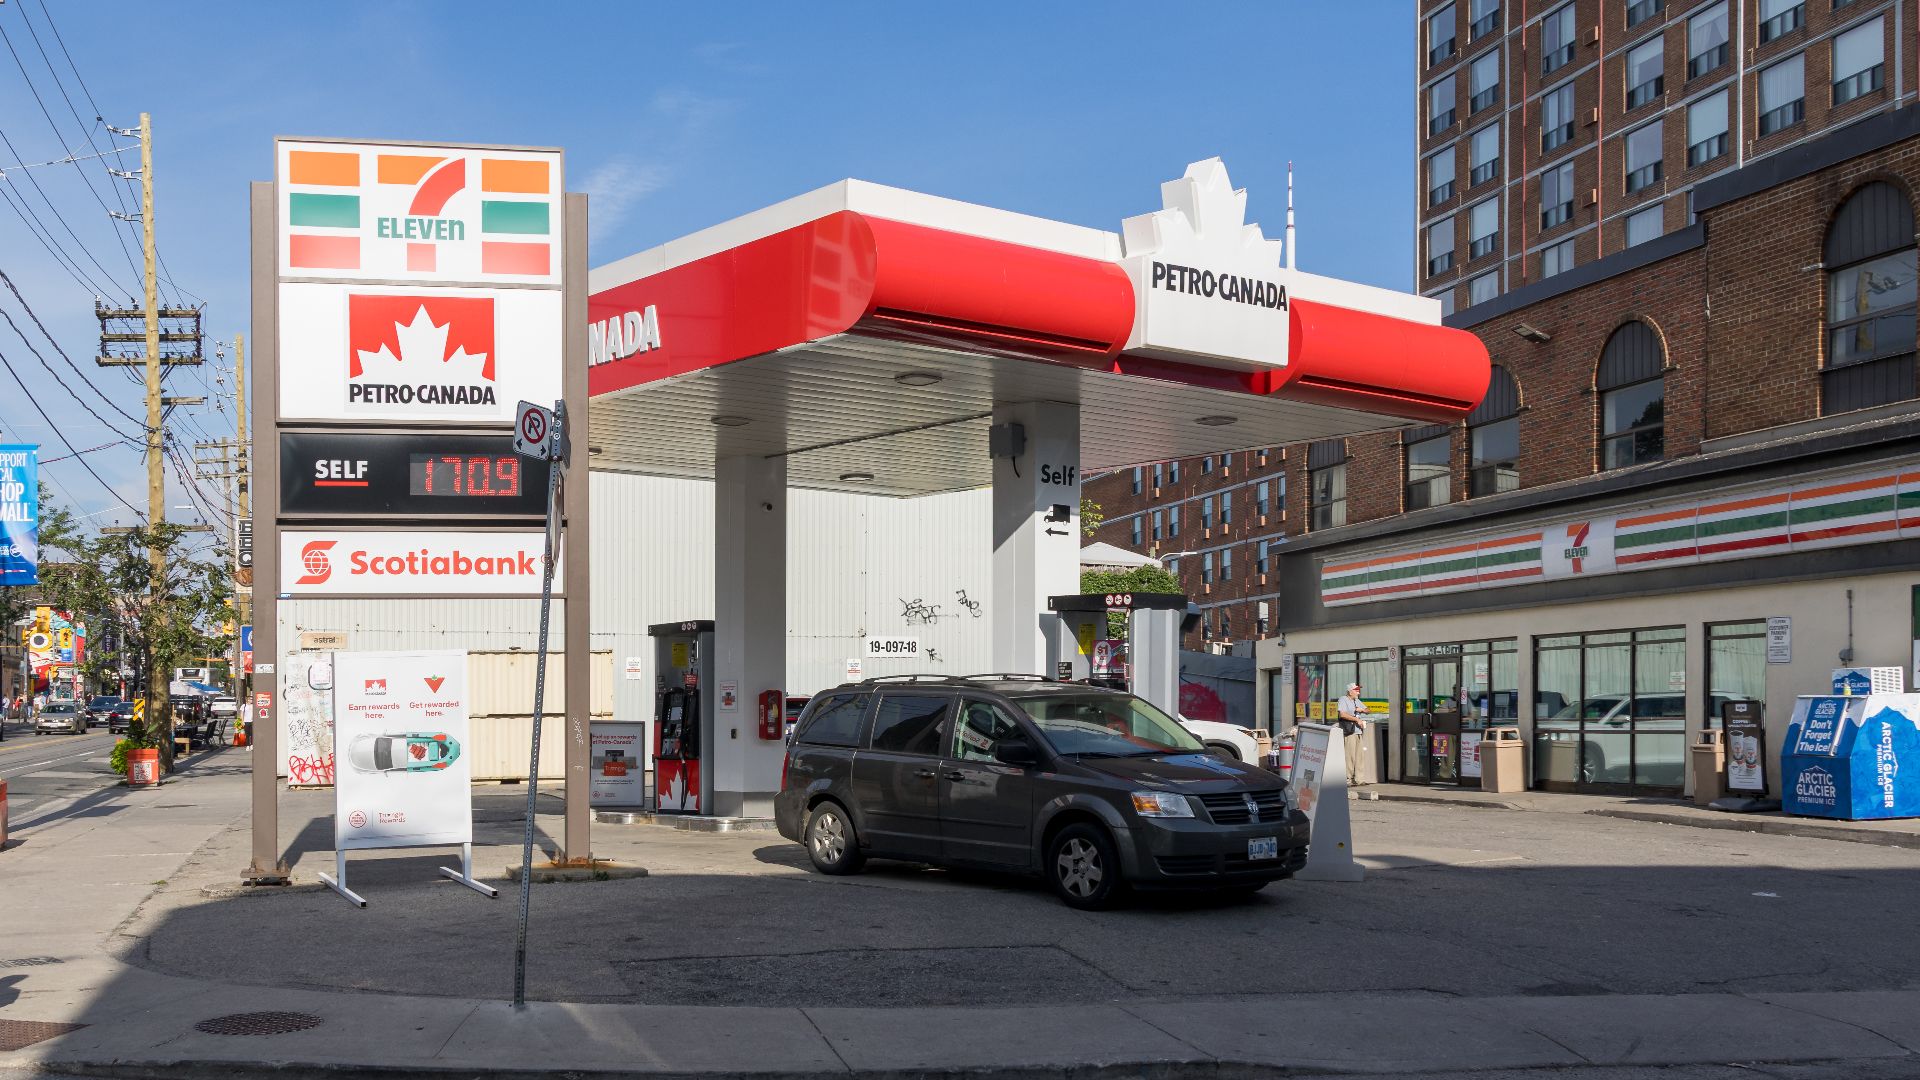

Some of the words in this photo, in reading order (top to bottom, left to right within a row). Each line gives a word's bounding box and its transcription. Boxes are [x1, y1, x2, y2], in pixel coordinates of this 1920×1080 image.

[1152, 261, 1288, 311] PETRO-CANADA
[349, 383, 496, 405] PETRO-CANADA
[314, 459, 369, 479] SELF
[1041, 464, 1075, 487] Self
[349, 548, 536, 576] Scotiabank
[869, 640, 917, 653] 19-097-18
[348, 703, 367, 711] Earn
[368, 702, 400, 710] rewards
[409, 701, 423, 709] Get
[424, 700, 460, 708] rewarded
[1810, 719, 1832, 729] Don't
[1804, 730, 1832, 741] Forget
[1881, 721, 1892, 760] ARCTIC
[1799, 742, 1814, 751] The
[1815, 743, 1832, 752] Ice!
[1798, 772, 1833, 785] ARCTIC
[1796, 784, 1836, 798] GLACIER
[1883, 763, 1894, 808] GLACIER
[1797, 796, 1824, 804] PREMIUM
[1825, 797, 1836, 805] ICE
